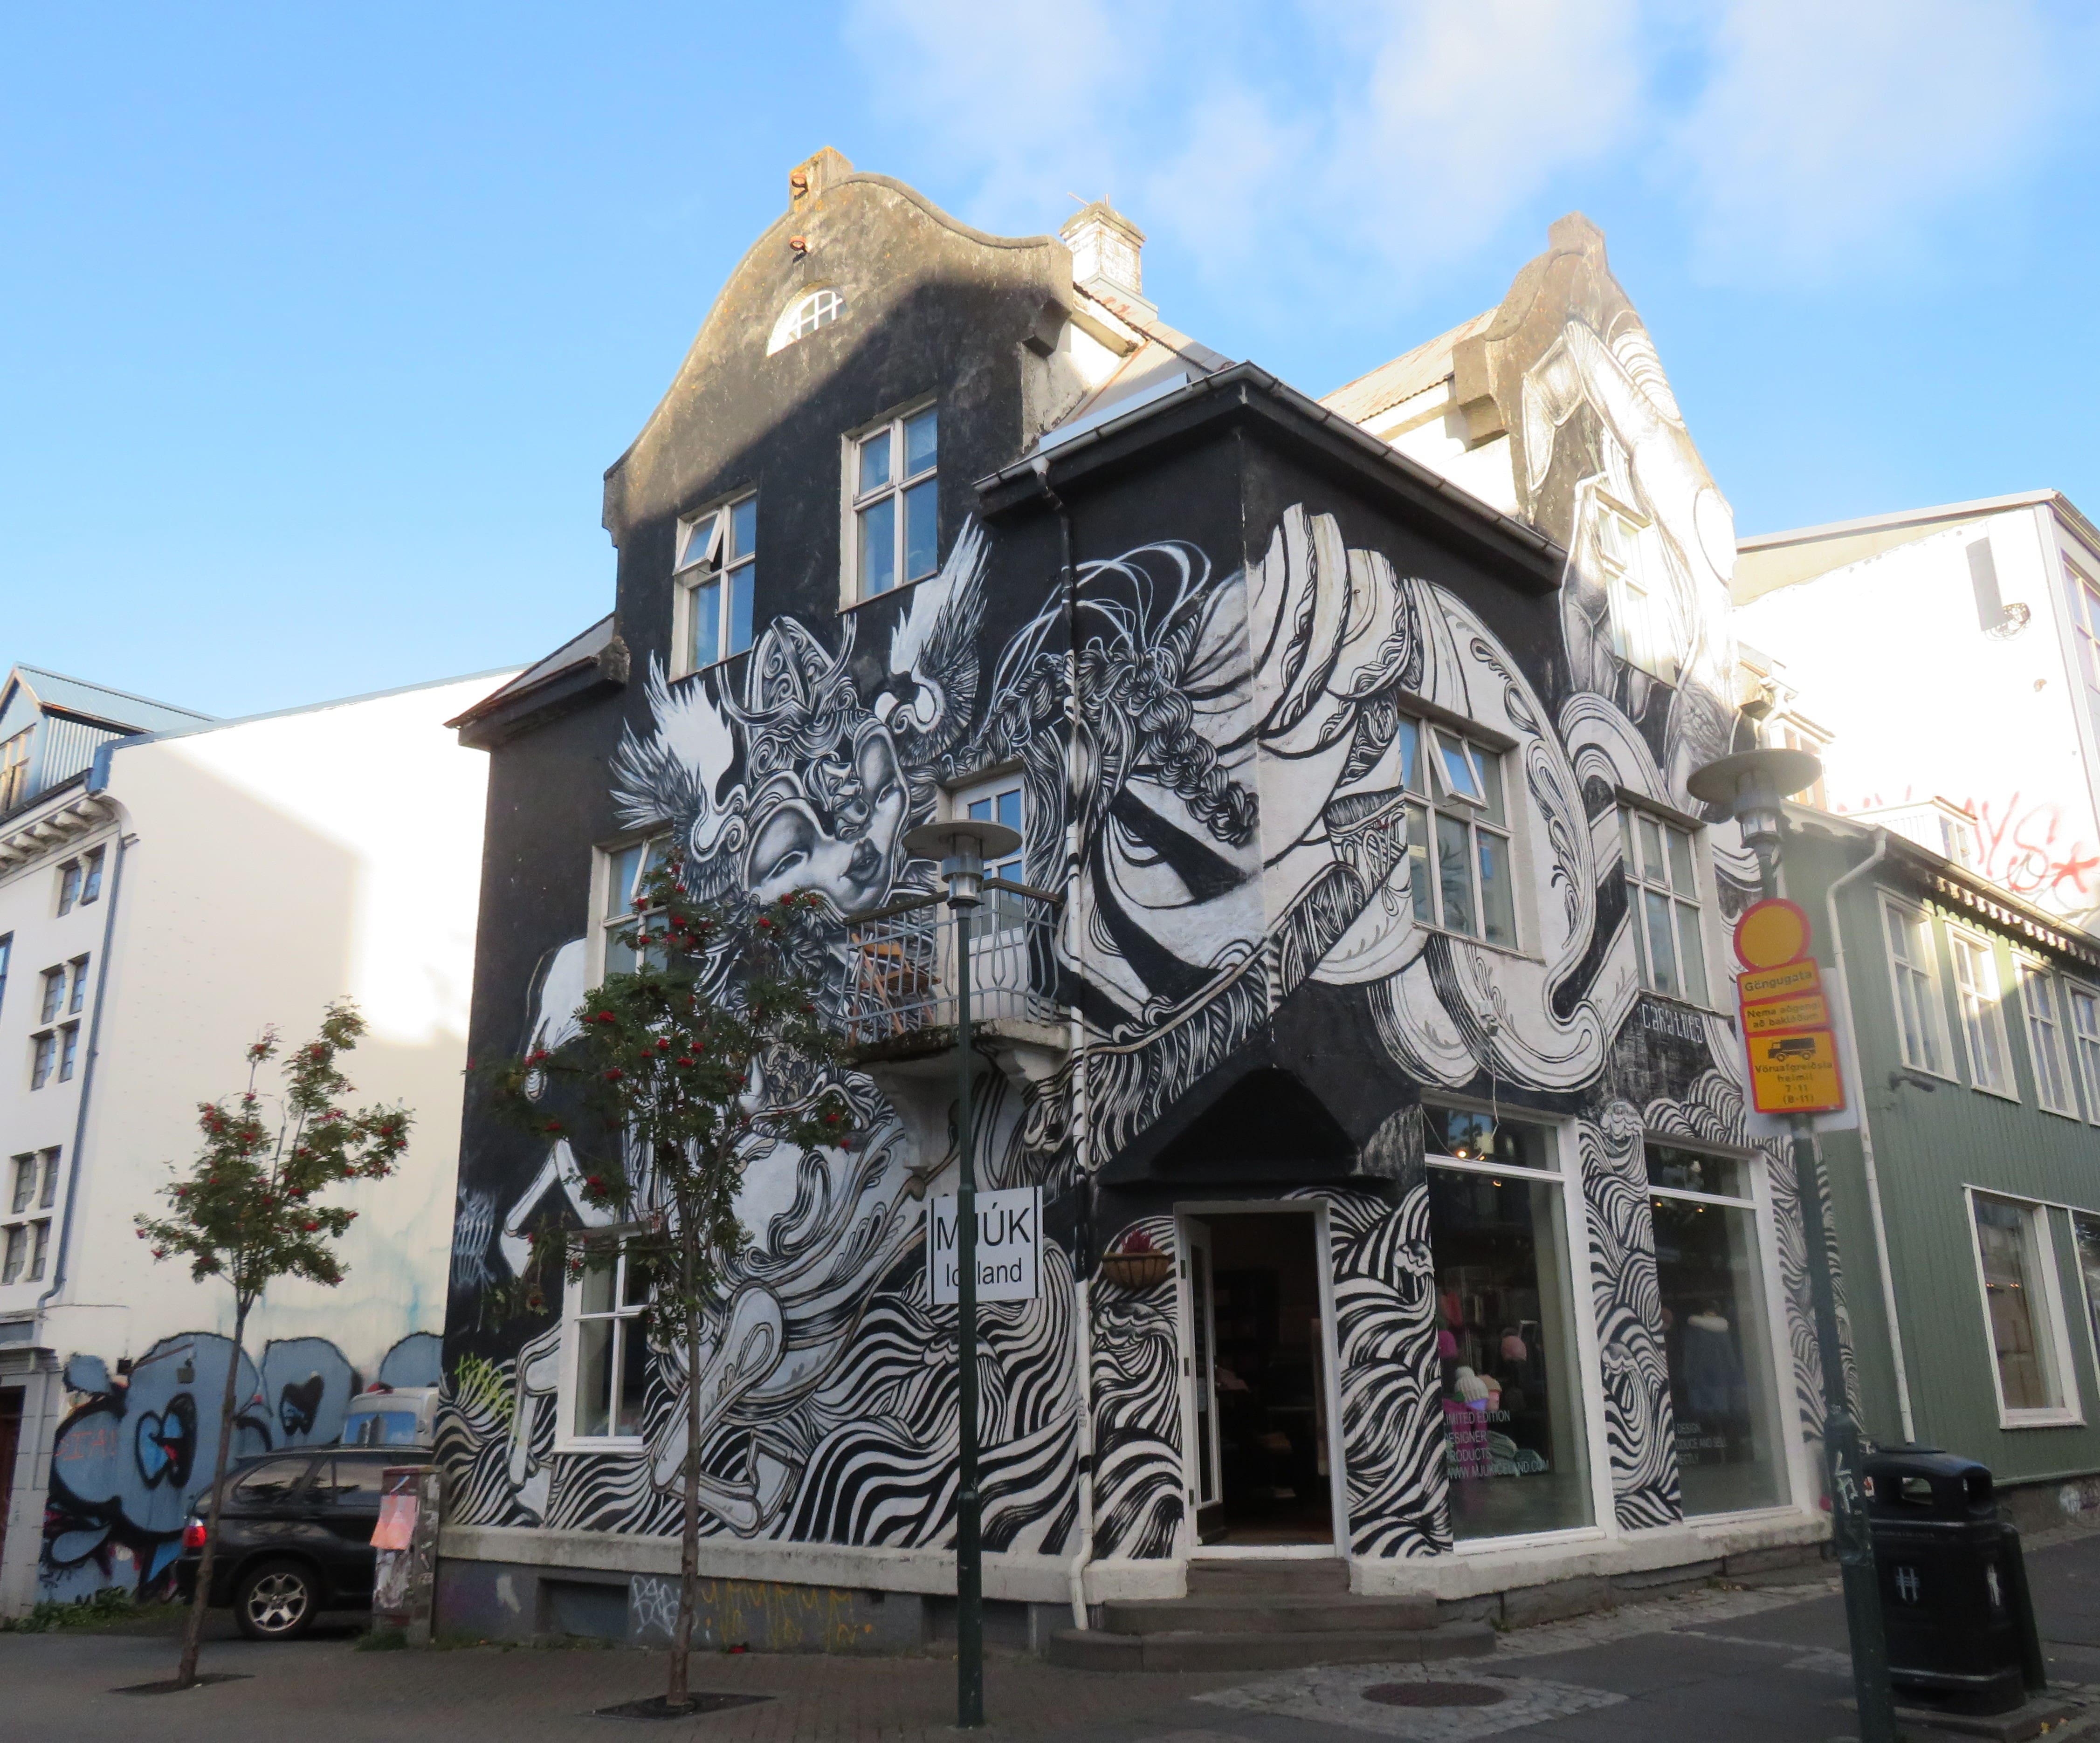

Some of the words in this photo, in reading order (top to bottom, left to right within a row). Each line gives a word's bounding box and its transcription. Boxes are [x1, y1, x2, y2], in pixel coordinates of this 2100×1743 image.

[1744, 971, 1812, 992] Göngugata
[1747, 1008, 1776, 1018] Nema
[1753, 1019, 1765, 1028] að
[1477, 1410, 1511, 1424] EDITION
